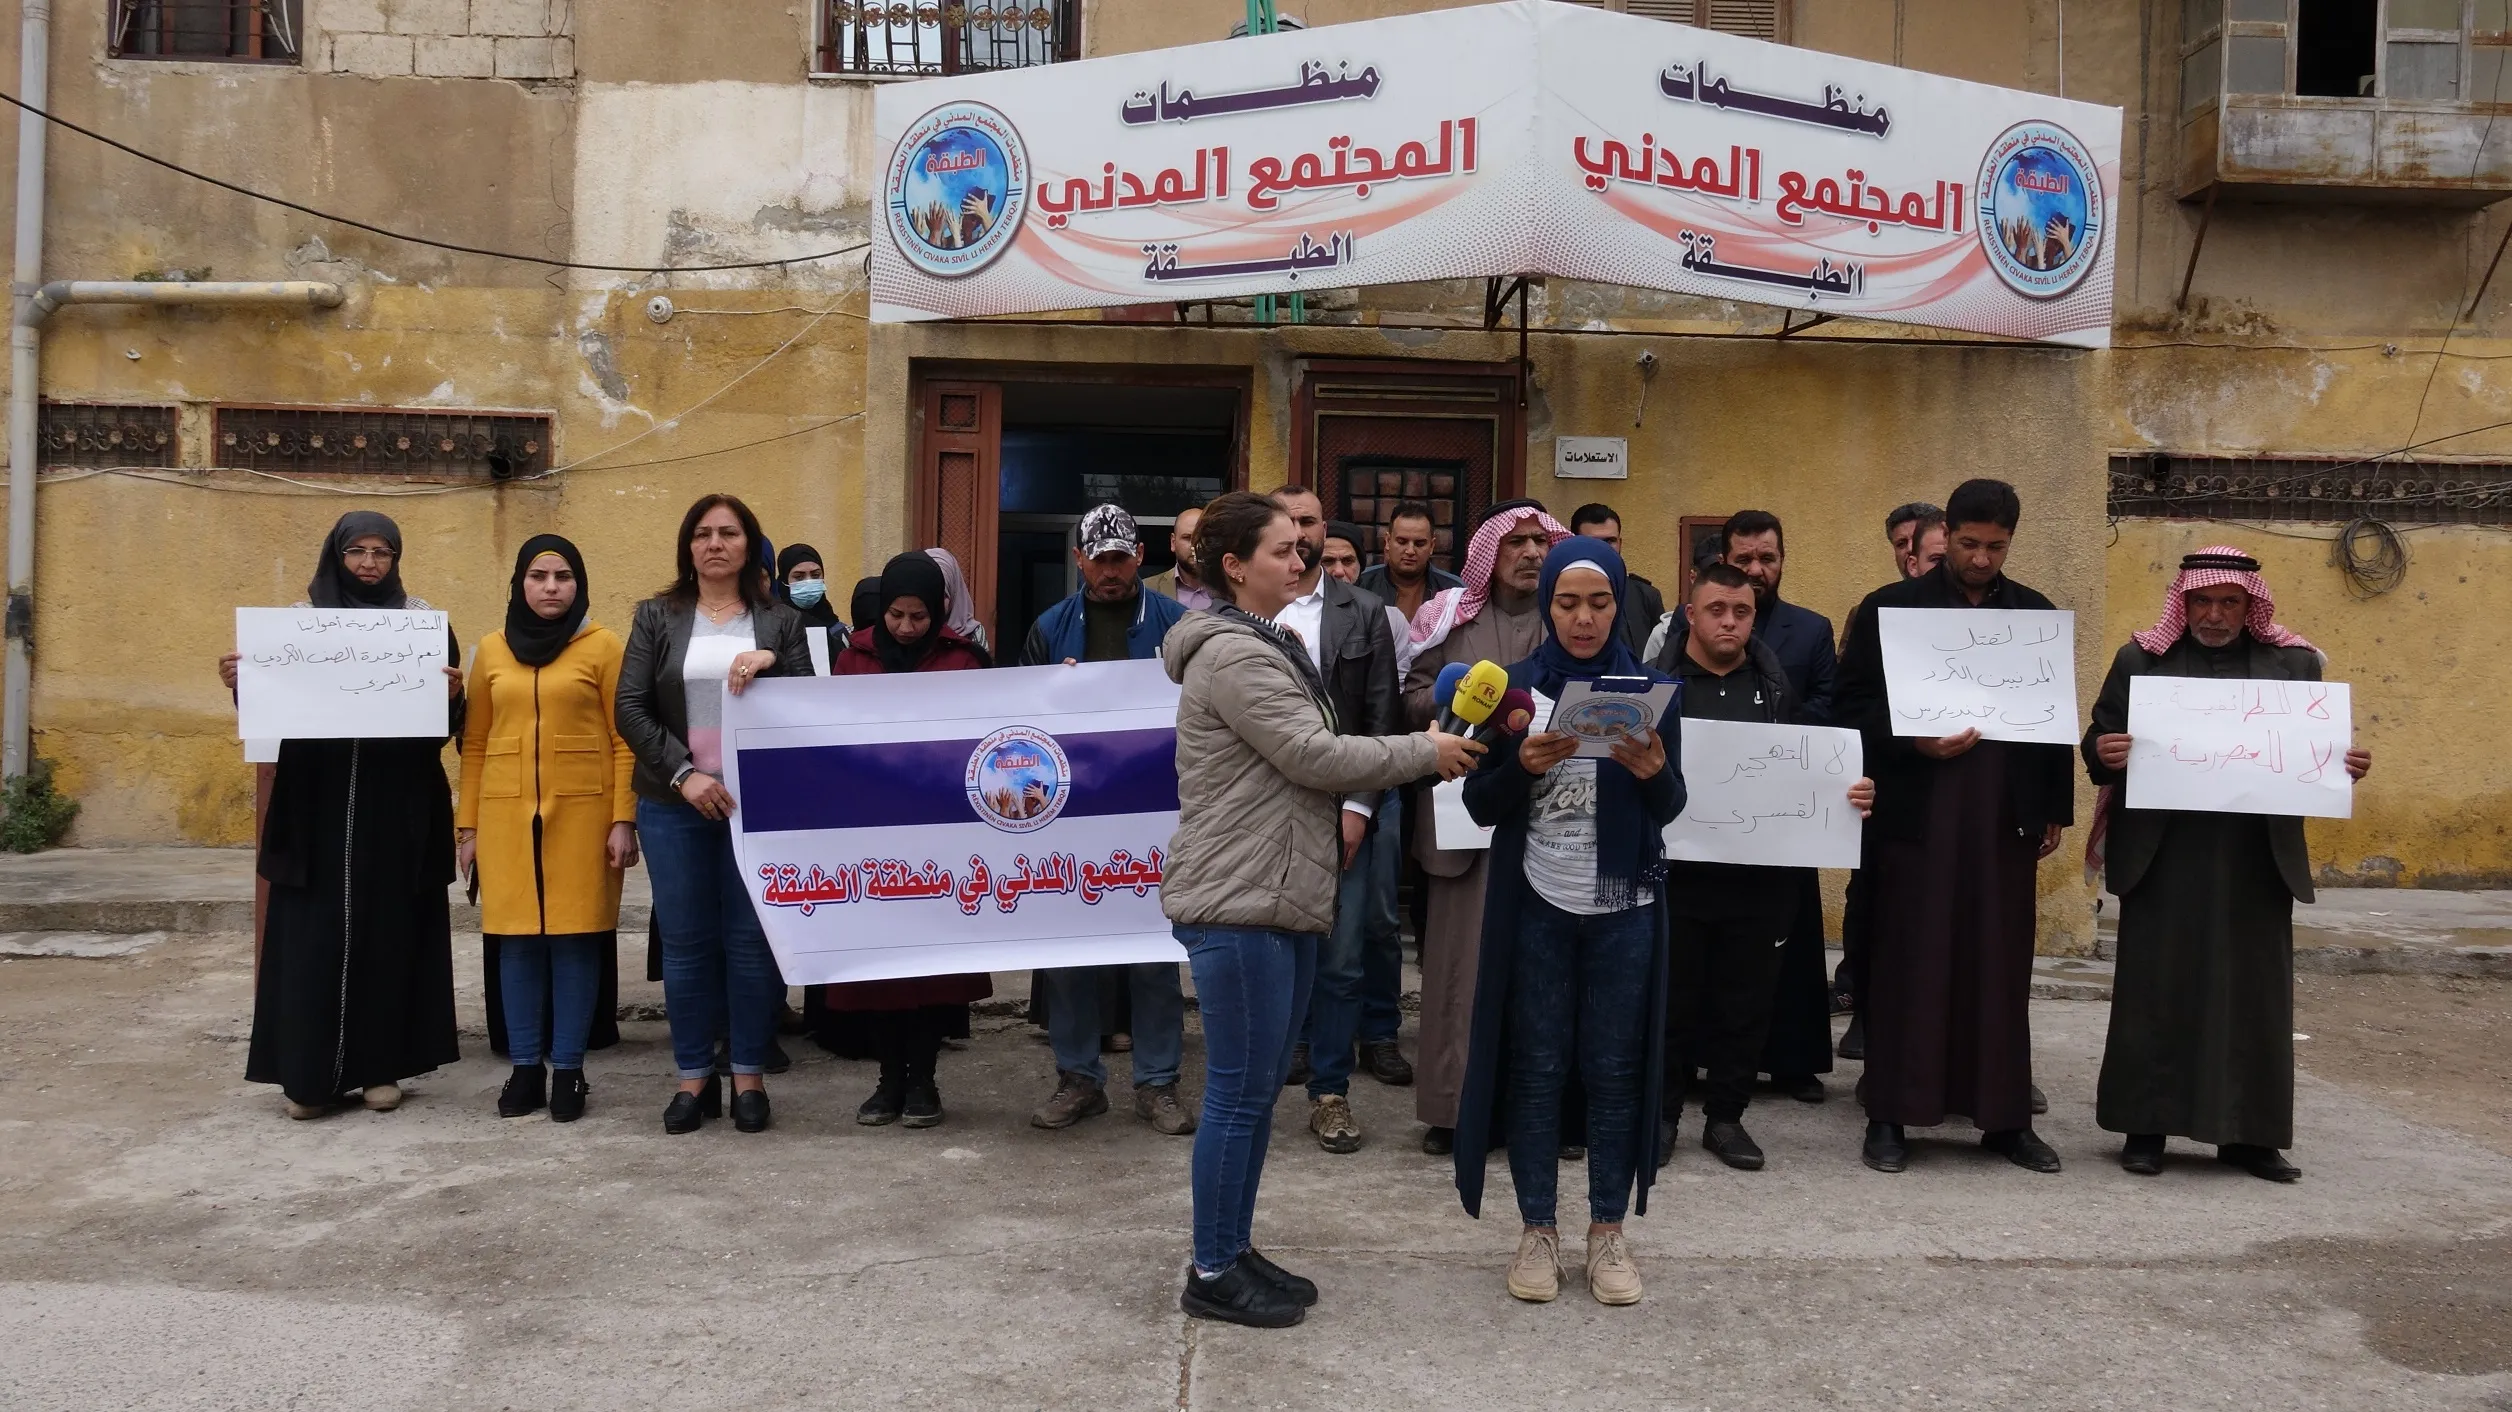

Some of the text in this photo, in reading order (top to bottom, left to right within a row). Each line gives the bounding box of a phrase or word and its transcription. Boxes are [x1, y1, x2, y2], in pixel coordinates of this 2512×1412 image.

[1121, 60, 1382, 126] منظمات
[1659, 60, 1892, 139] منظمات
[932, 117, 942, 132] في
[943, 112, 976, 128] المدني
[974, 115, 1008, 140] المجتمع
[904, 124, 931, 150] منطقة
[1994, 136, 2020, 158] منطقة
[2021, 131, 2030, 147] في
[2031, 130, 2060, 145] المدني
[926, 148, 987, 175] الطبقة
[2059, 141, 2089, 172] المجتمع
[1035, 114, 1480, 230] المجتمع المدني
[1572, 132, 1965, 236] المجتمع المدني
[2015, 167, 2069, 196] الطبقة
[923, 251, 950, 264] CIVAKA
[1001, 200, 1019, 232] TEBQA
[1143, 234, 1354, 283] الطبقة
[1680, 230, 1865, 302] الطبقة
[2009, 265, 2033, 284] CIVAKA
[1565, 451, 1618, 463] الاستعلامات
[2022, 623, 2059, 646] لا
[253, 643, 305, 667] الكردي
[418, 644, 441, 667] نعم
[1483, 687, 1496, 699] R
[2306, 684, 2330, 720] لا
[2000, 701, 2055, 731] في
[995, 753, 1040, 770] الطبقة
[1824, 740, 1846, 775] لا
[2297, 740, 2332, 783] لا
[758, 863, 862, 917] الطبقة
[861, 858, 954, 900] منطقة
[956, 853, 992, 916] في
[994, 852, 1077, 914] المدني
